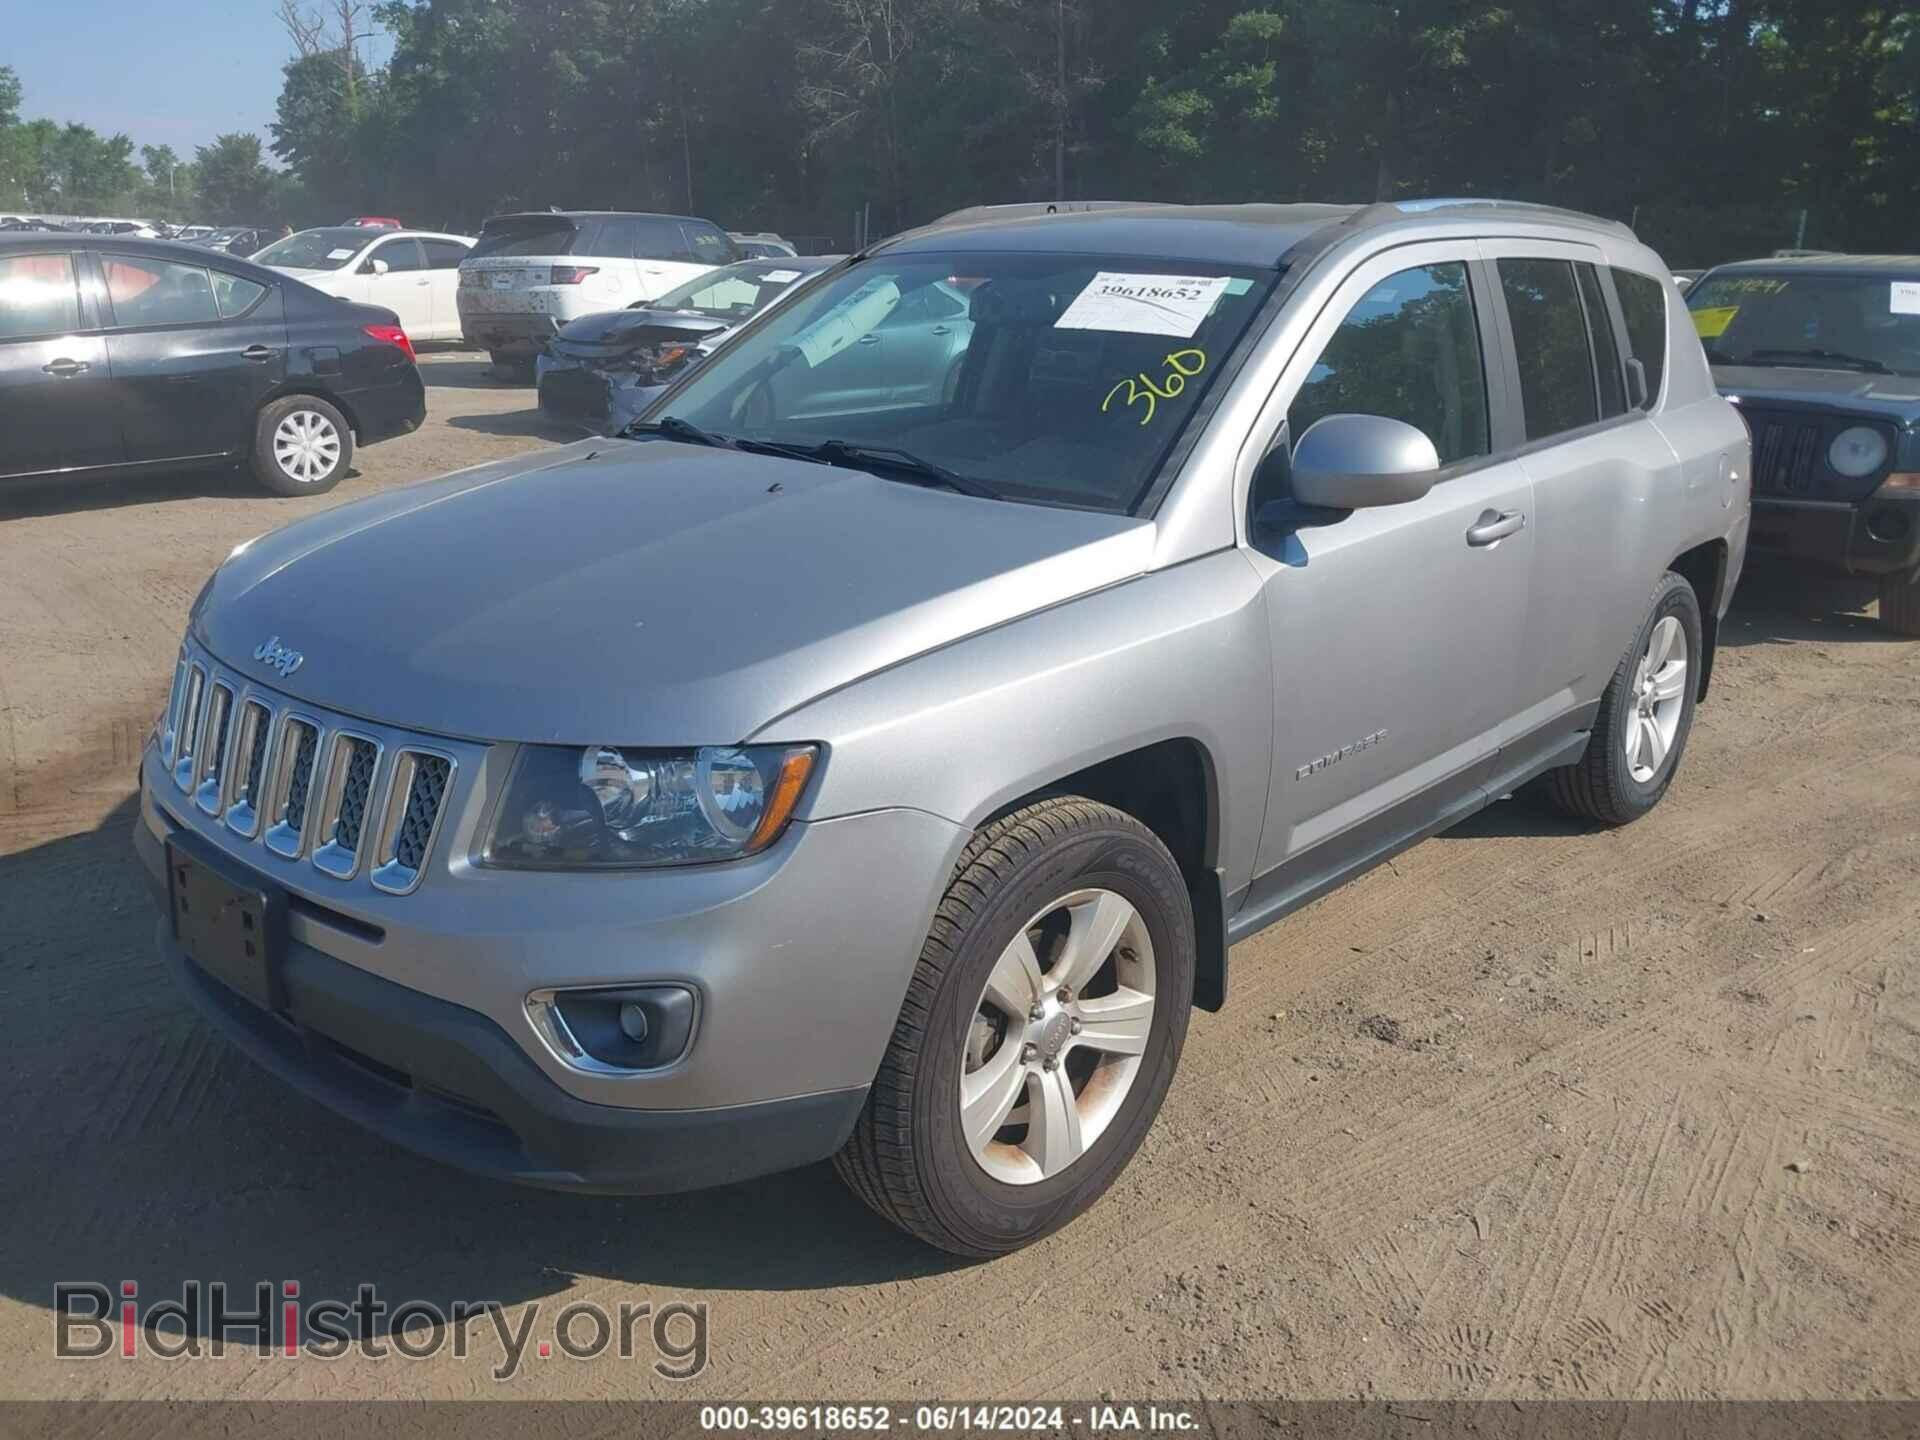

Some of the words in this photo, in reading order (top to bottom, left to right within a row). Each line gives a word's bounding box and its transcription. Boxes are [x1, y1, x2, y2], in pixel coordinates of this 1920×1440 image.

[1102, 285, 1203, 301] 39618652
[1102, 349, 1206, 425] 360
[254, 635, 304, 677] Jeep
